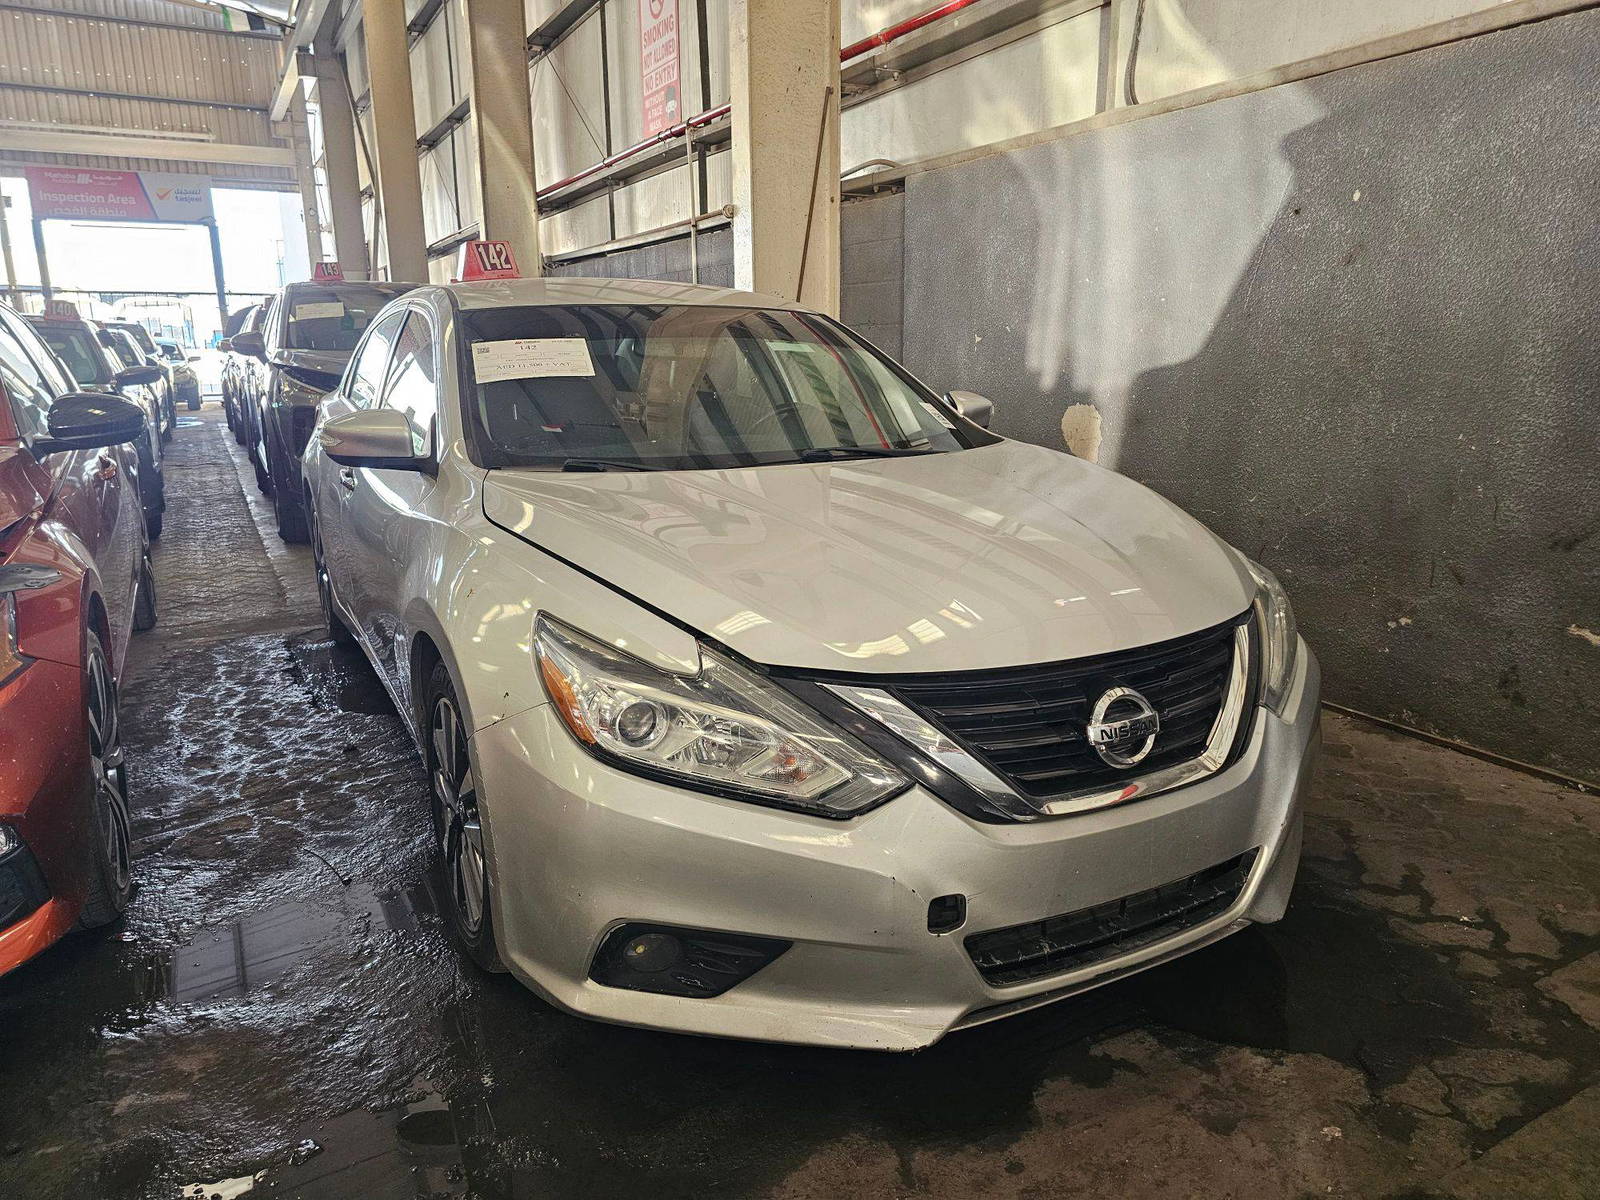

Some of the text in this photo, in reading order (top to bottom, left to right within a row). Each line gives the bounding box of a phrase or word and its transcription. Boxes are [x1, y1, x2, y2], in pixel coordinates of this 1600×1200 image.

[643, 14, 675, 49] SMOKING
[643, 38, 676, 71] NOT ALLOWED
[644, 61, 677, 95] NO ENTRY
[39, 190, 136, 205] Inspection Area
[320, 262, 339, 277] 143
[478, 243, 512, 270] 142
[1100, 717, 1158, 741] NISSAN
